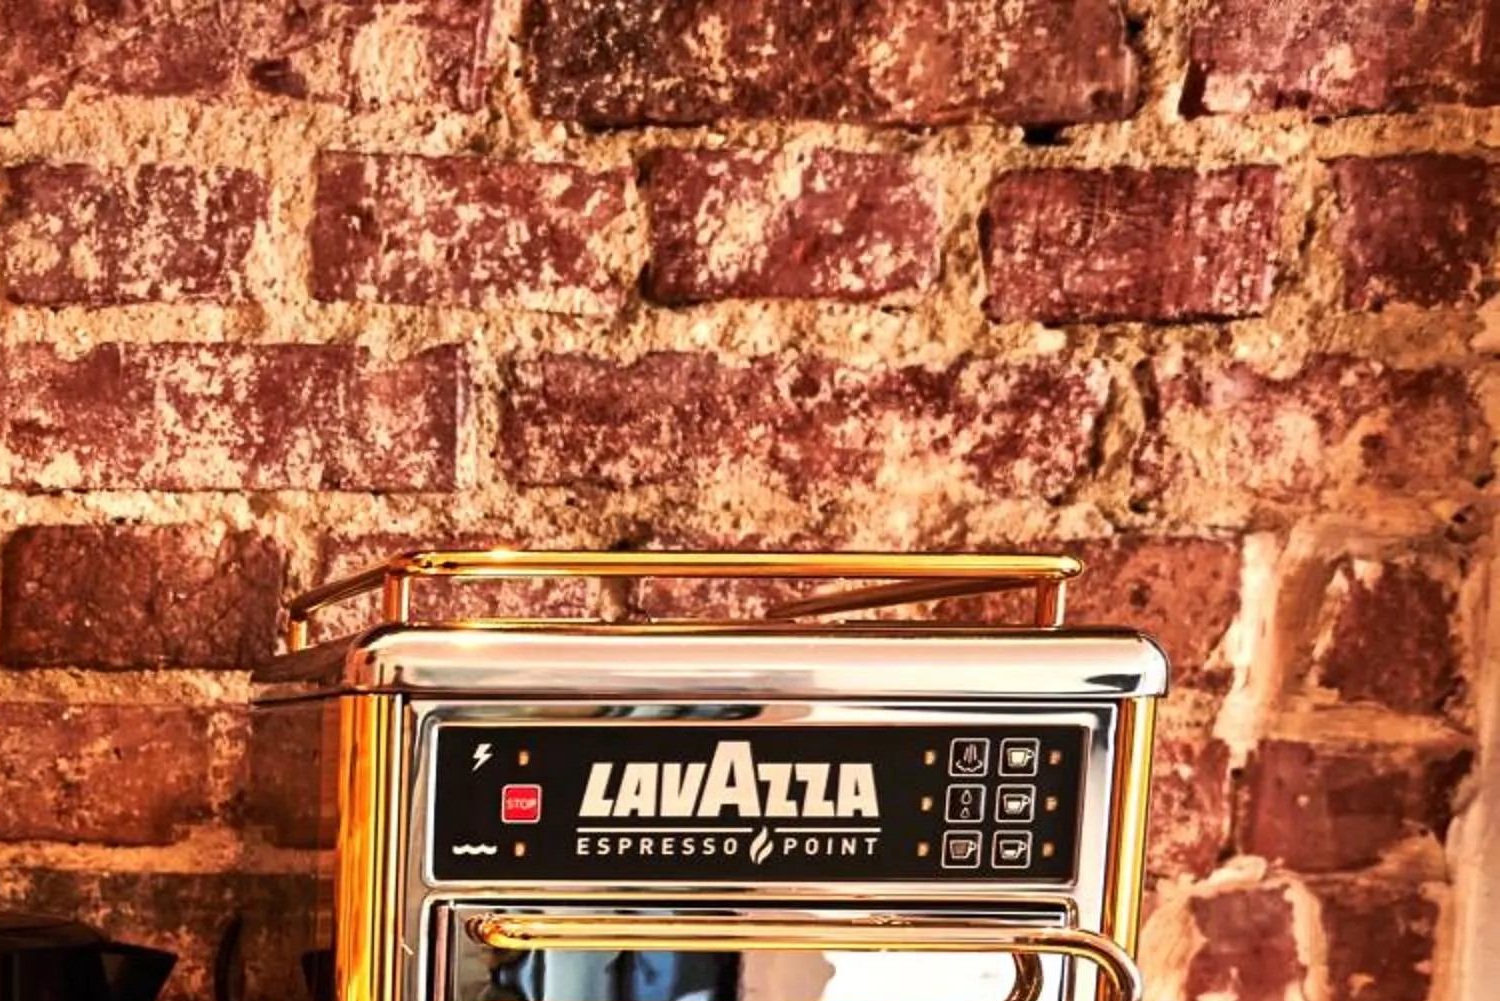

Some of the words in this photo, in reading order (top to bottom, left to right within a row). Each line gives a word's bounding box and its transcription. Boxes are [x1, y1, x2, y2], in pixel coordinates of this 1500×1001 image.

[578, 740, 880, 818] LAVAZZA
[506, 797, 538, 810] STOP
[576, 837, 739, 856] ESPRESSO
[783, 837, 879, 856] POINT
